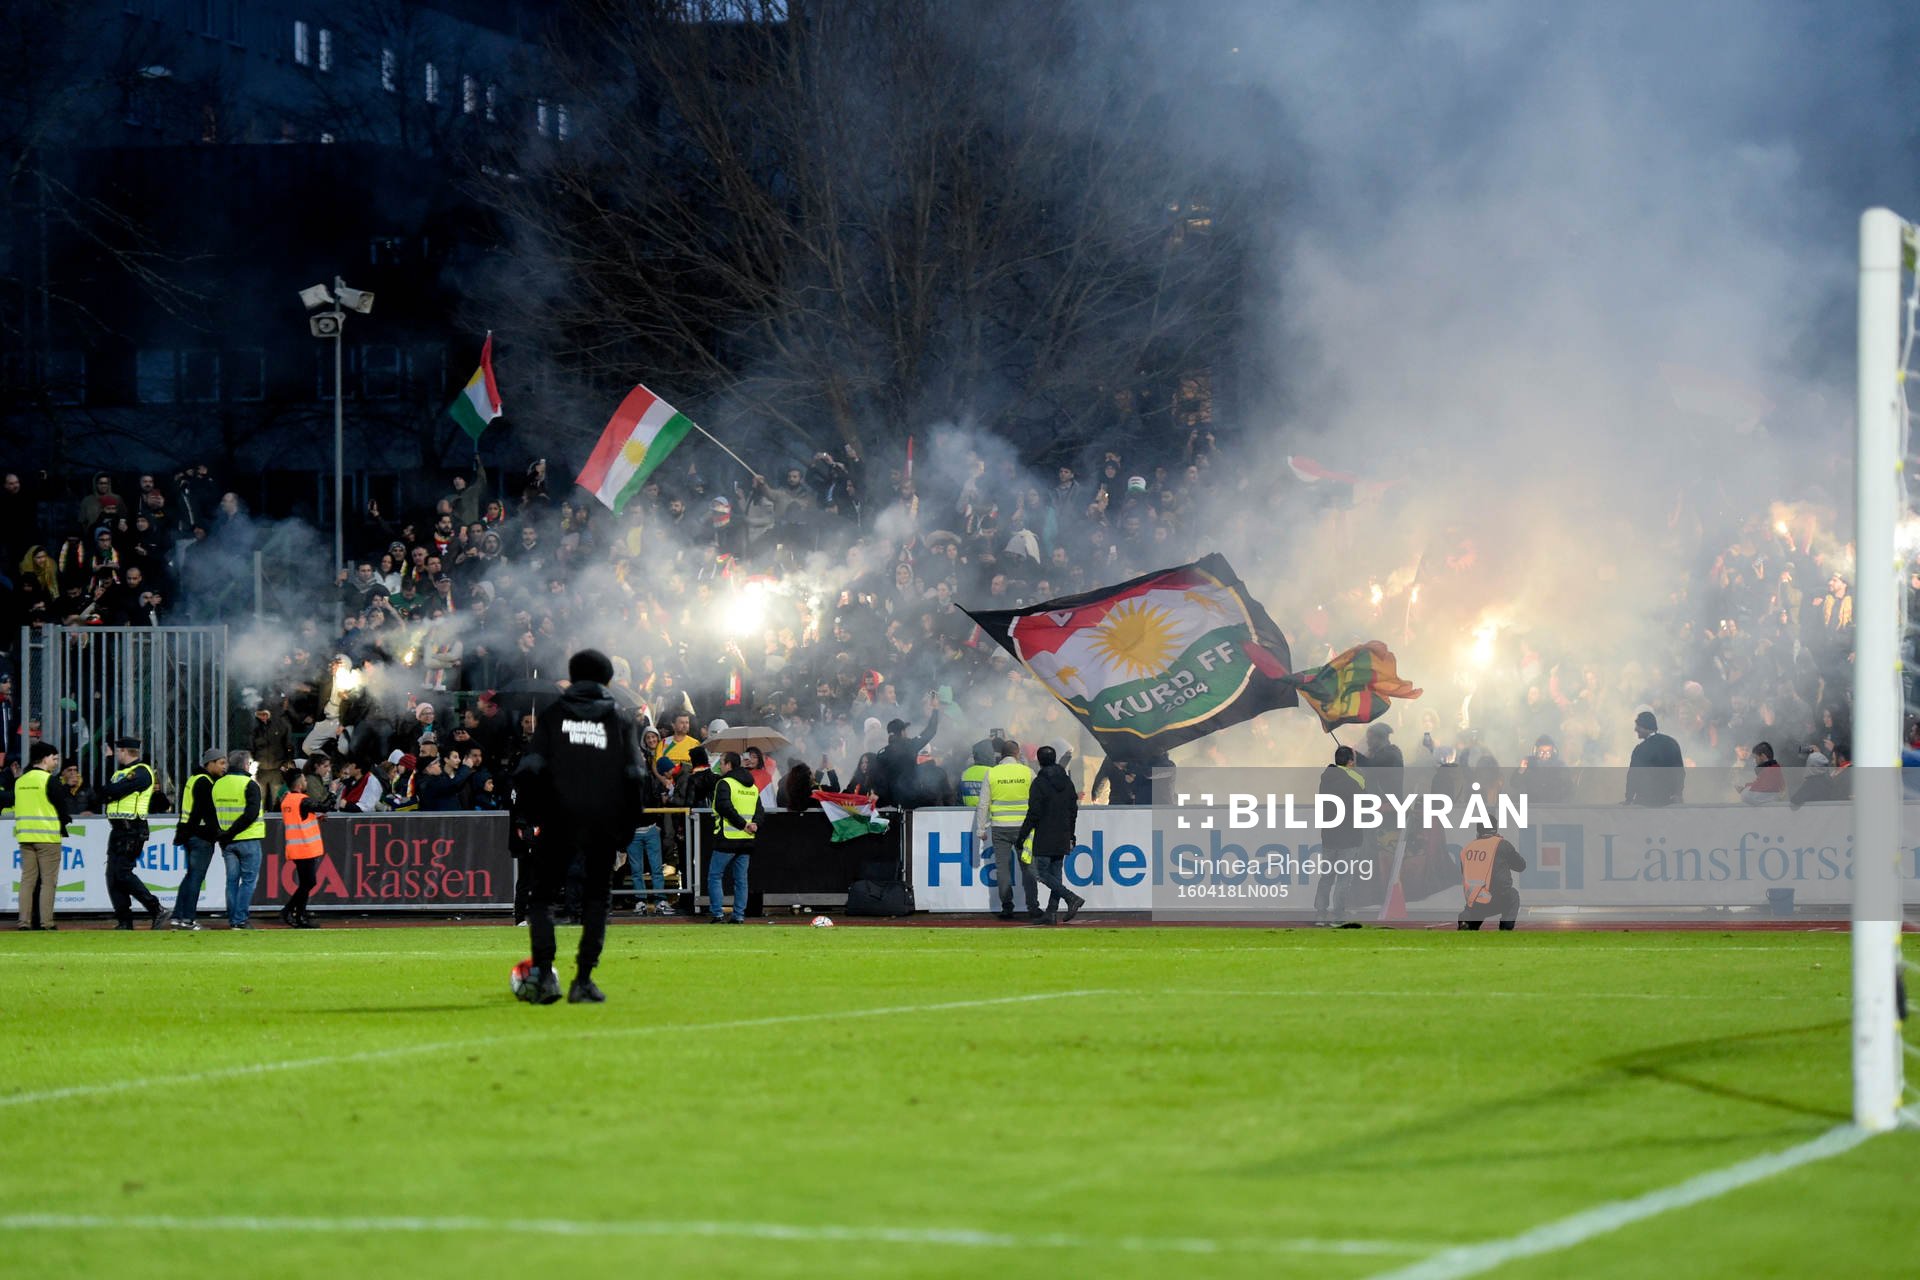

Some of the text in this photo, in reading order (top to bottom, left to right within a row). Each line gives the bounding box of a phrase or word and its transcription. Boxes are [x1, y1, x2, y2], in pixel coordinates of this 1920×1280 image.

[1104, 641, 1235, 721] KURD FF
[1162, 681, 1209, 712] 2004
[354, 823, 455, 873] Torg
[1466, 849, 1487, 862] OTO
[353, 853, 493, 898] kassen
